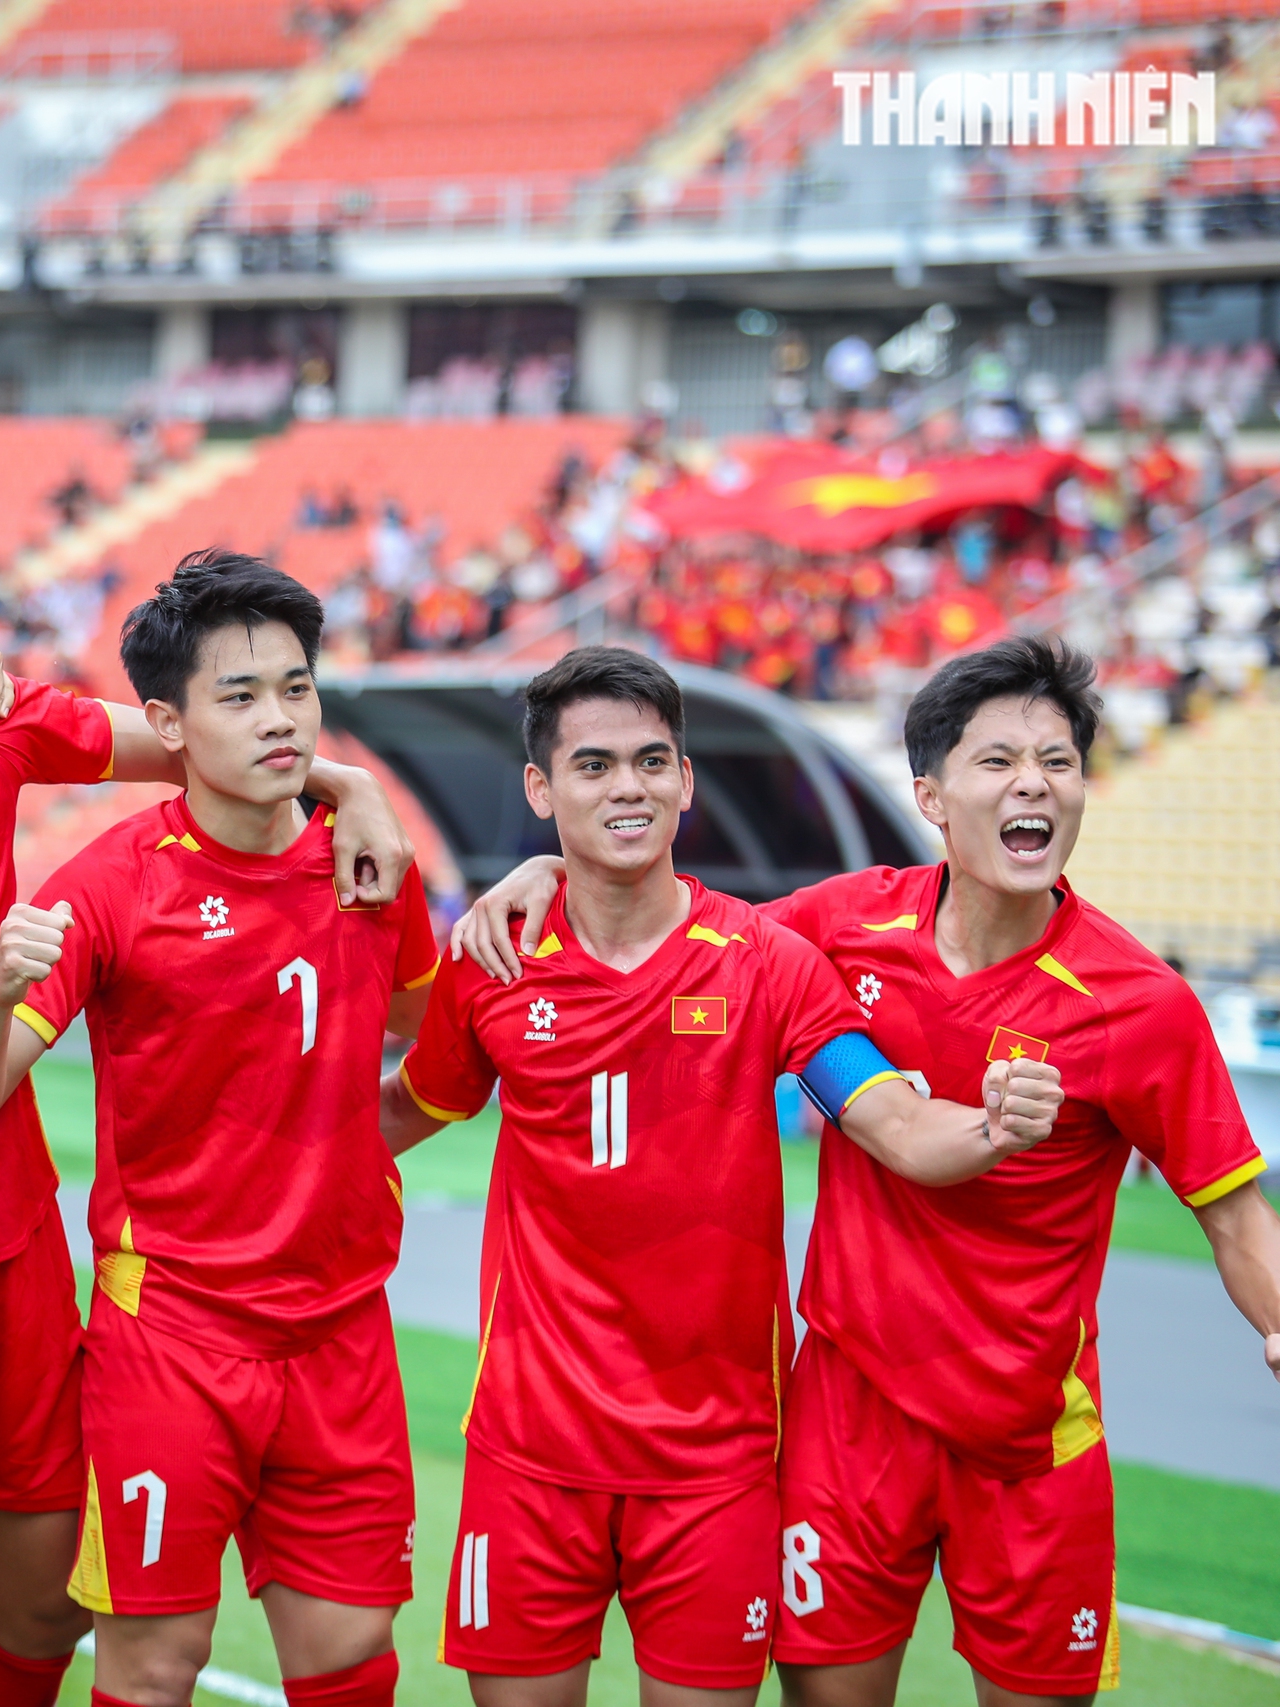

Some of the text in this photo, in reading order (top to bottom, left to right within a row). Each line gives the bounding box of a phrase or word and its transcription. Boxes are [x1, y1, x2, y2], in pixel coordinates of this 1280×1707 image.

[276, 955, 319, 1057] 7
[591, 1069, 629, 1170] 11
[122, 1469, 168, 1569] 7
[782, 1520, 825, 1618] 8
[459, 1531, 490, 1631] 11
